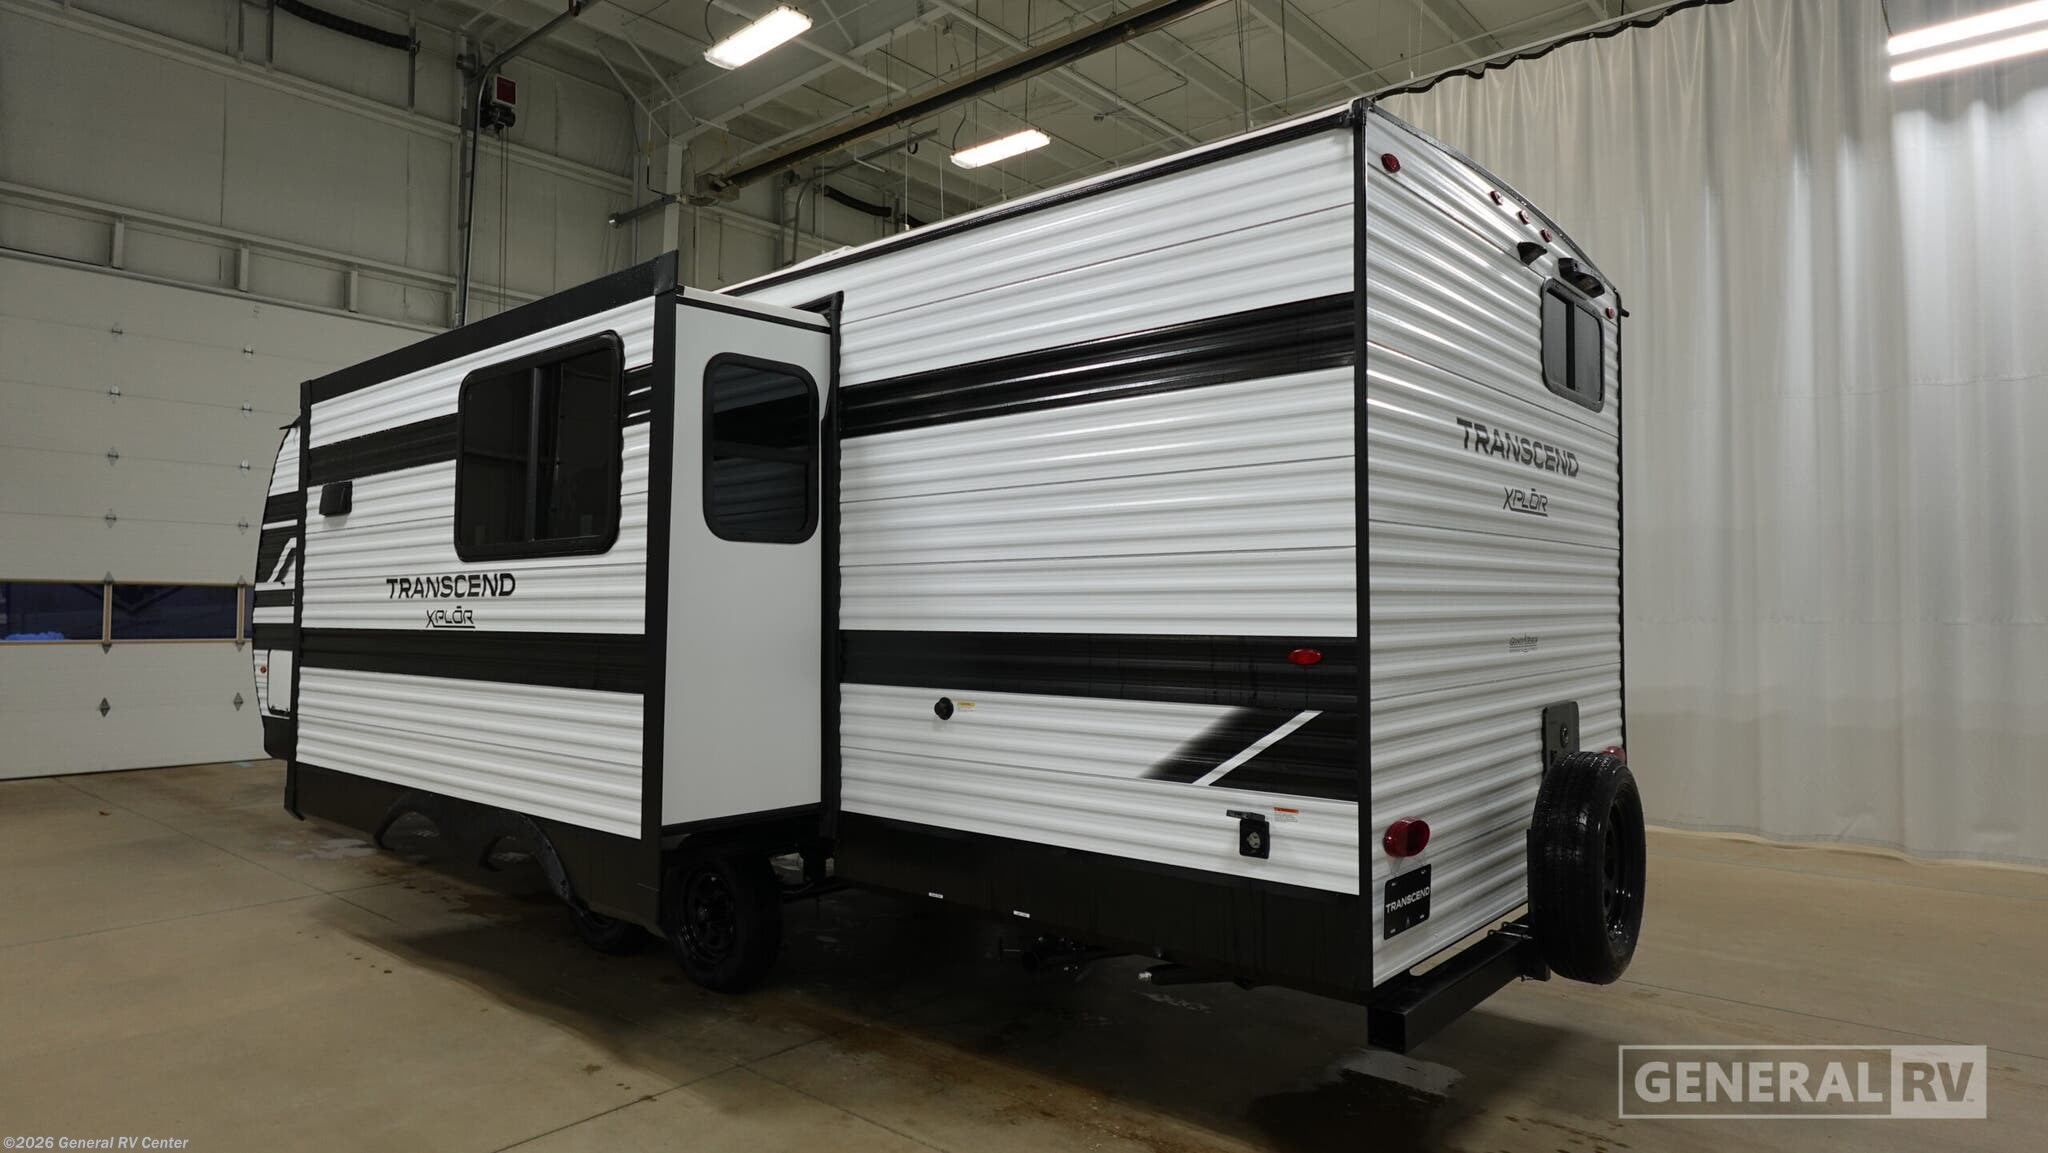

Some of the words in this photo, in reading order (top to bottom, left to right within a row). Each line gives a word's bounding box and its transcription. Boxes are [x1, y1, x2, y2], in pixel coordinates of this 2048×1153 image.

[1456, 416, 1579, 477] TRANSCEND
[386, 573, 516, 599] TRANSCEND
[1385, 886, 1431, 914] TRANSCEND
